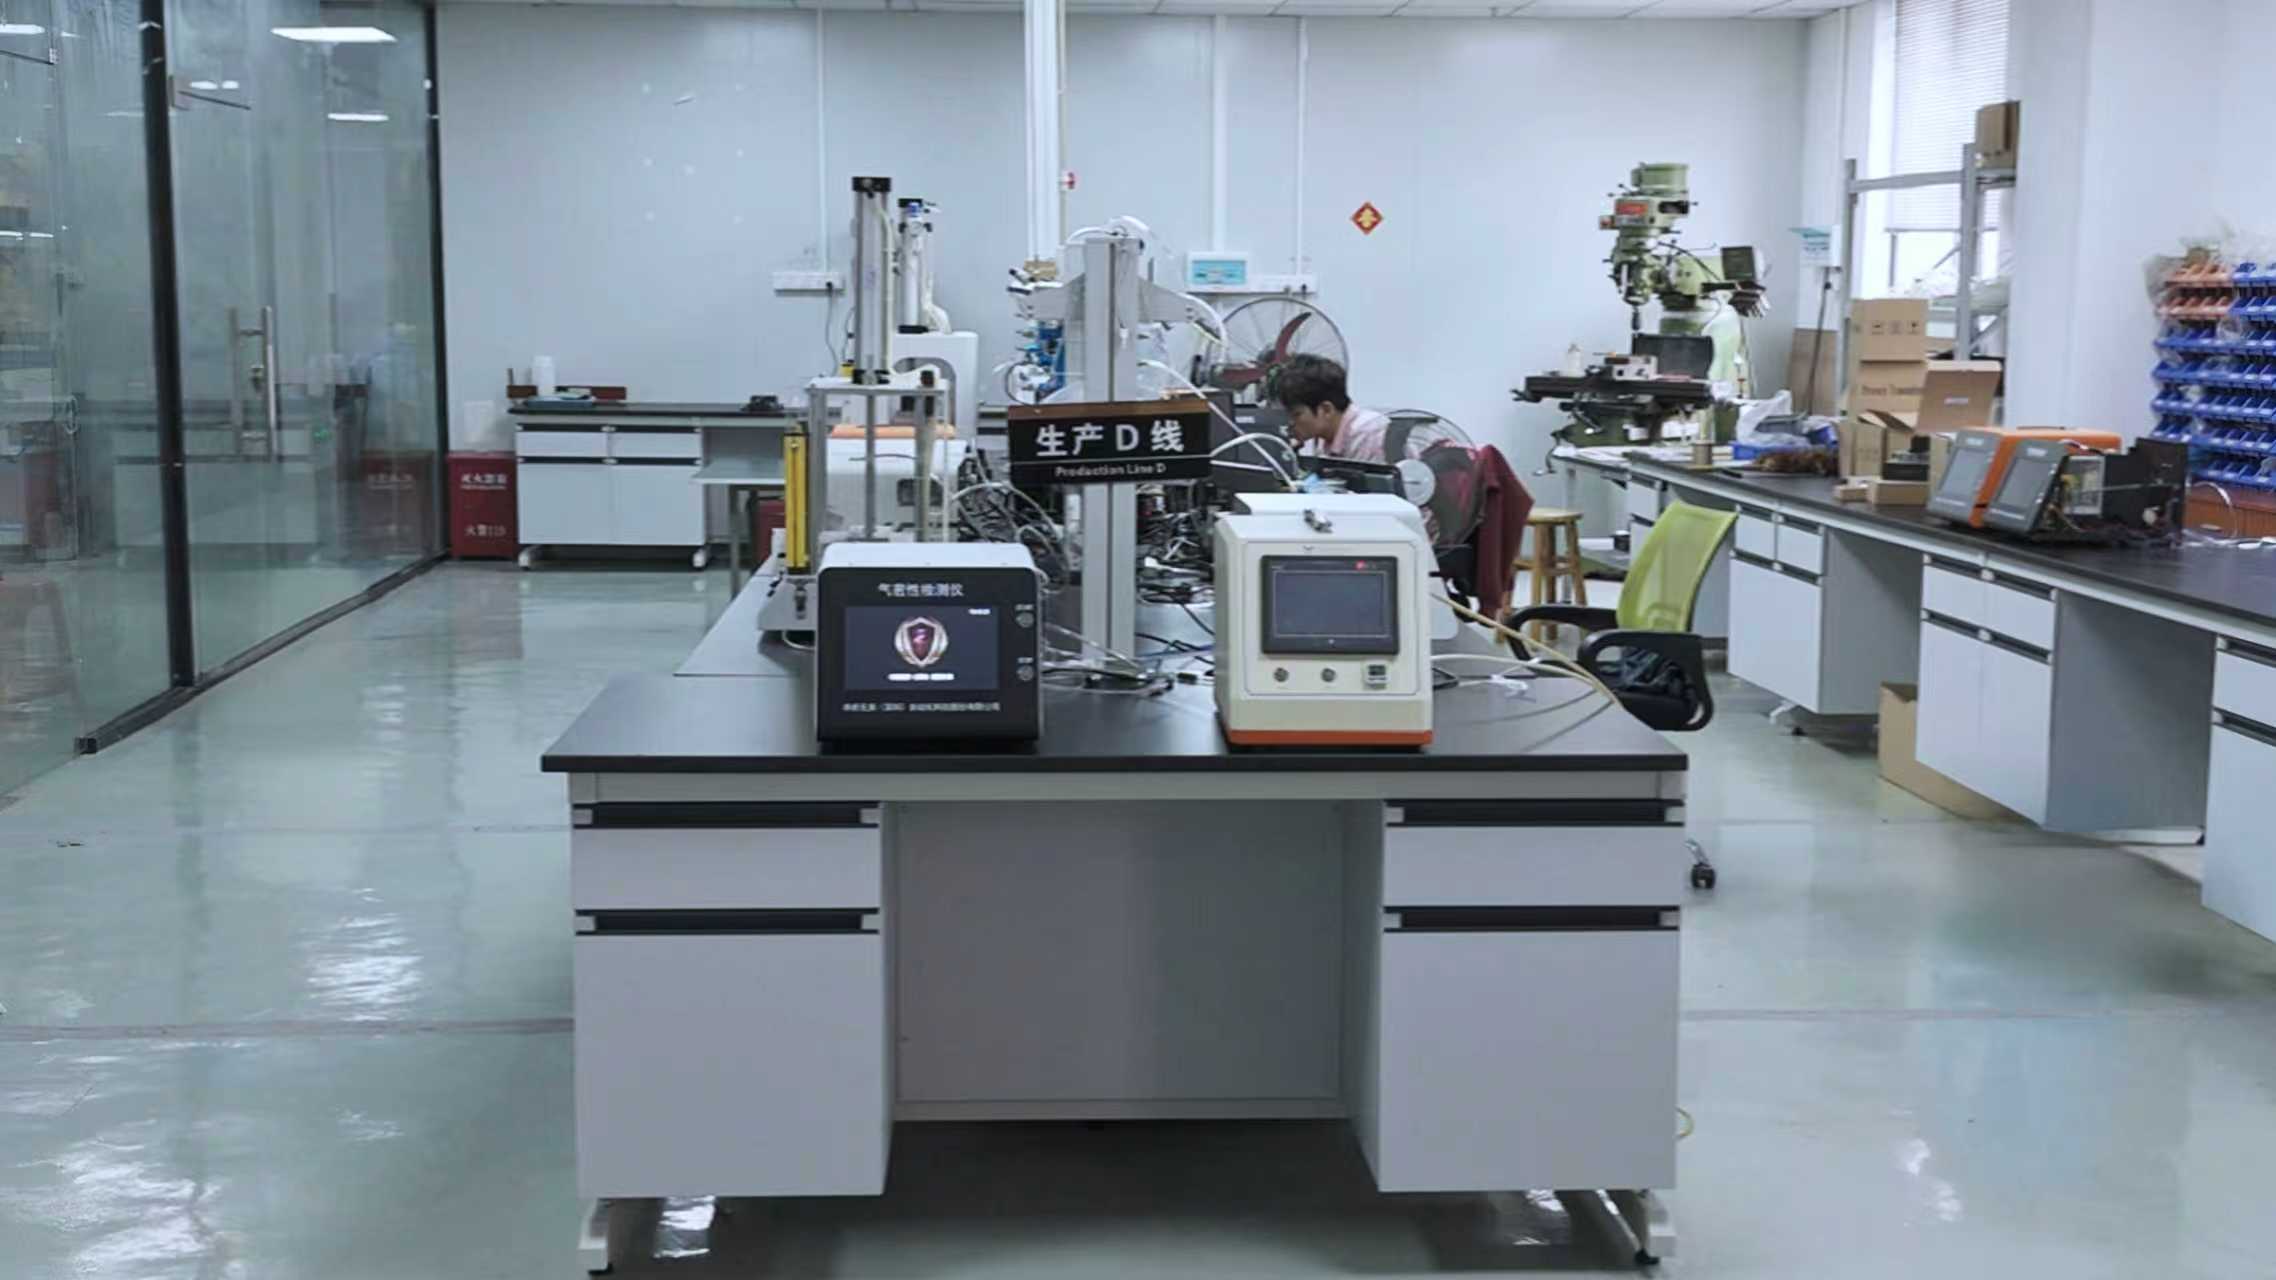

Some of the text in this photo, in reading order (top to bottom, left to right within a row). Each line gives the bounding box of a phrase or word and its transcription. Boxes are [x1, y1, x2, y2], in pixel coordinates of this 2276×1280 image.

[1055, 462, 1167, 477] Production Line D
